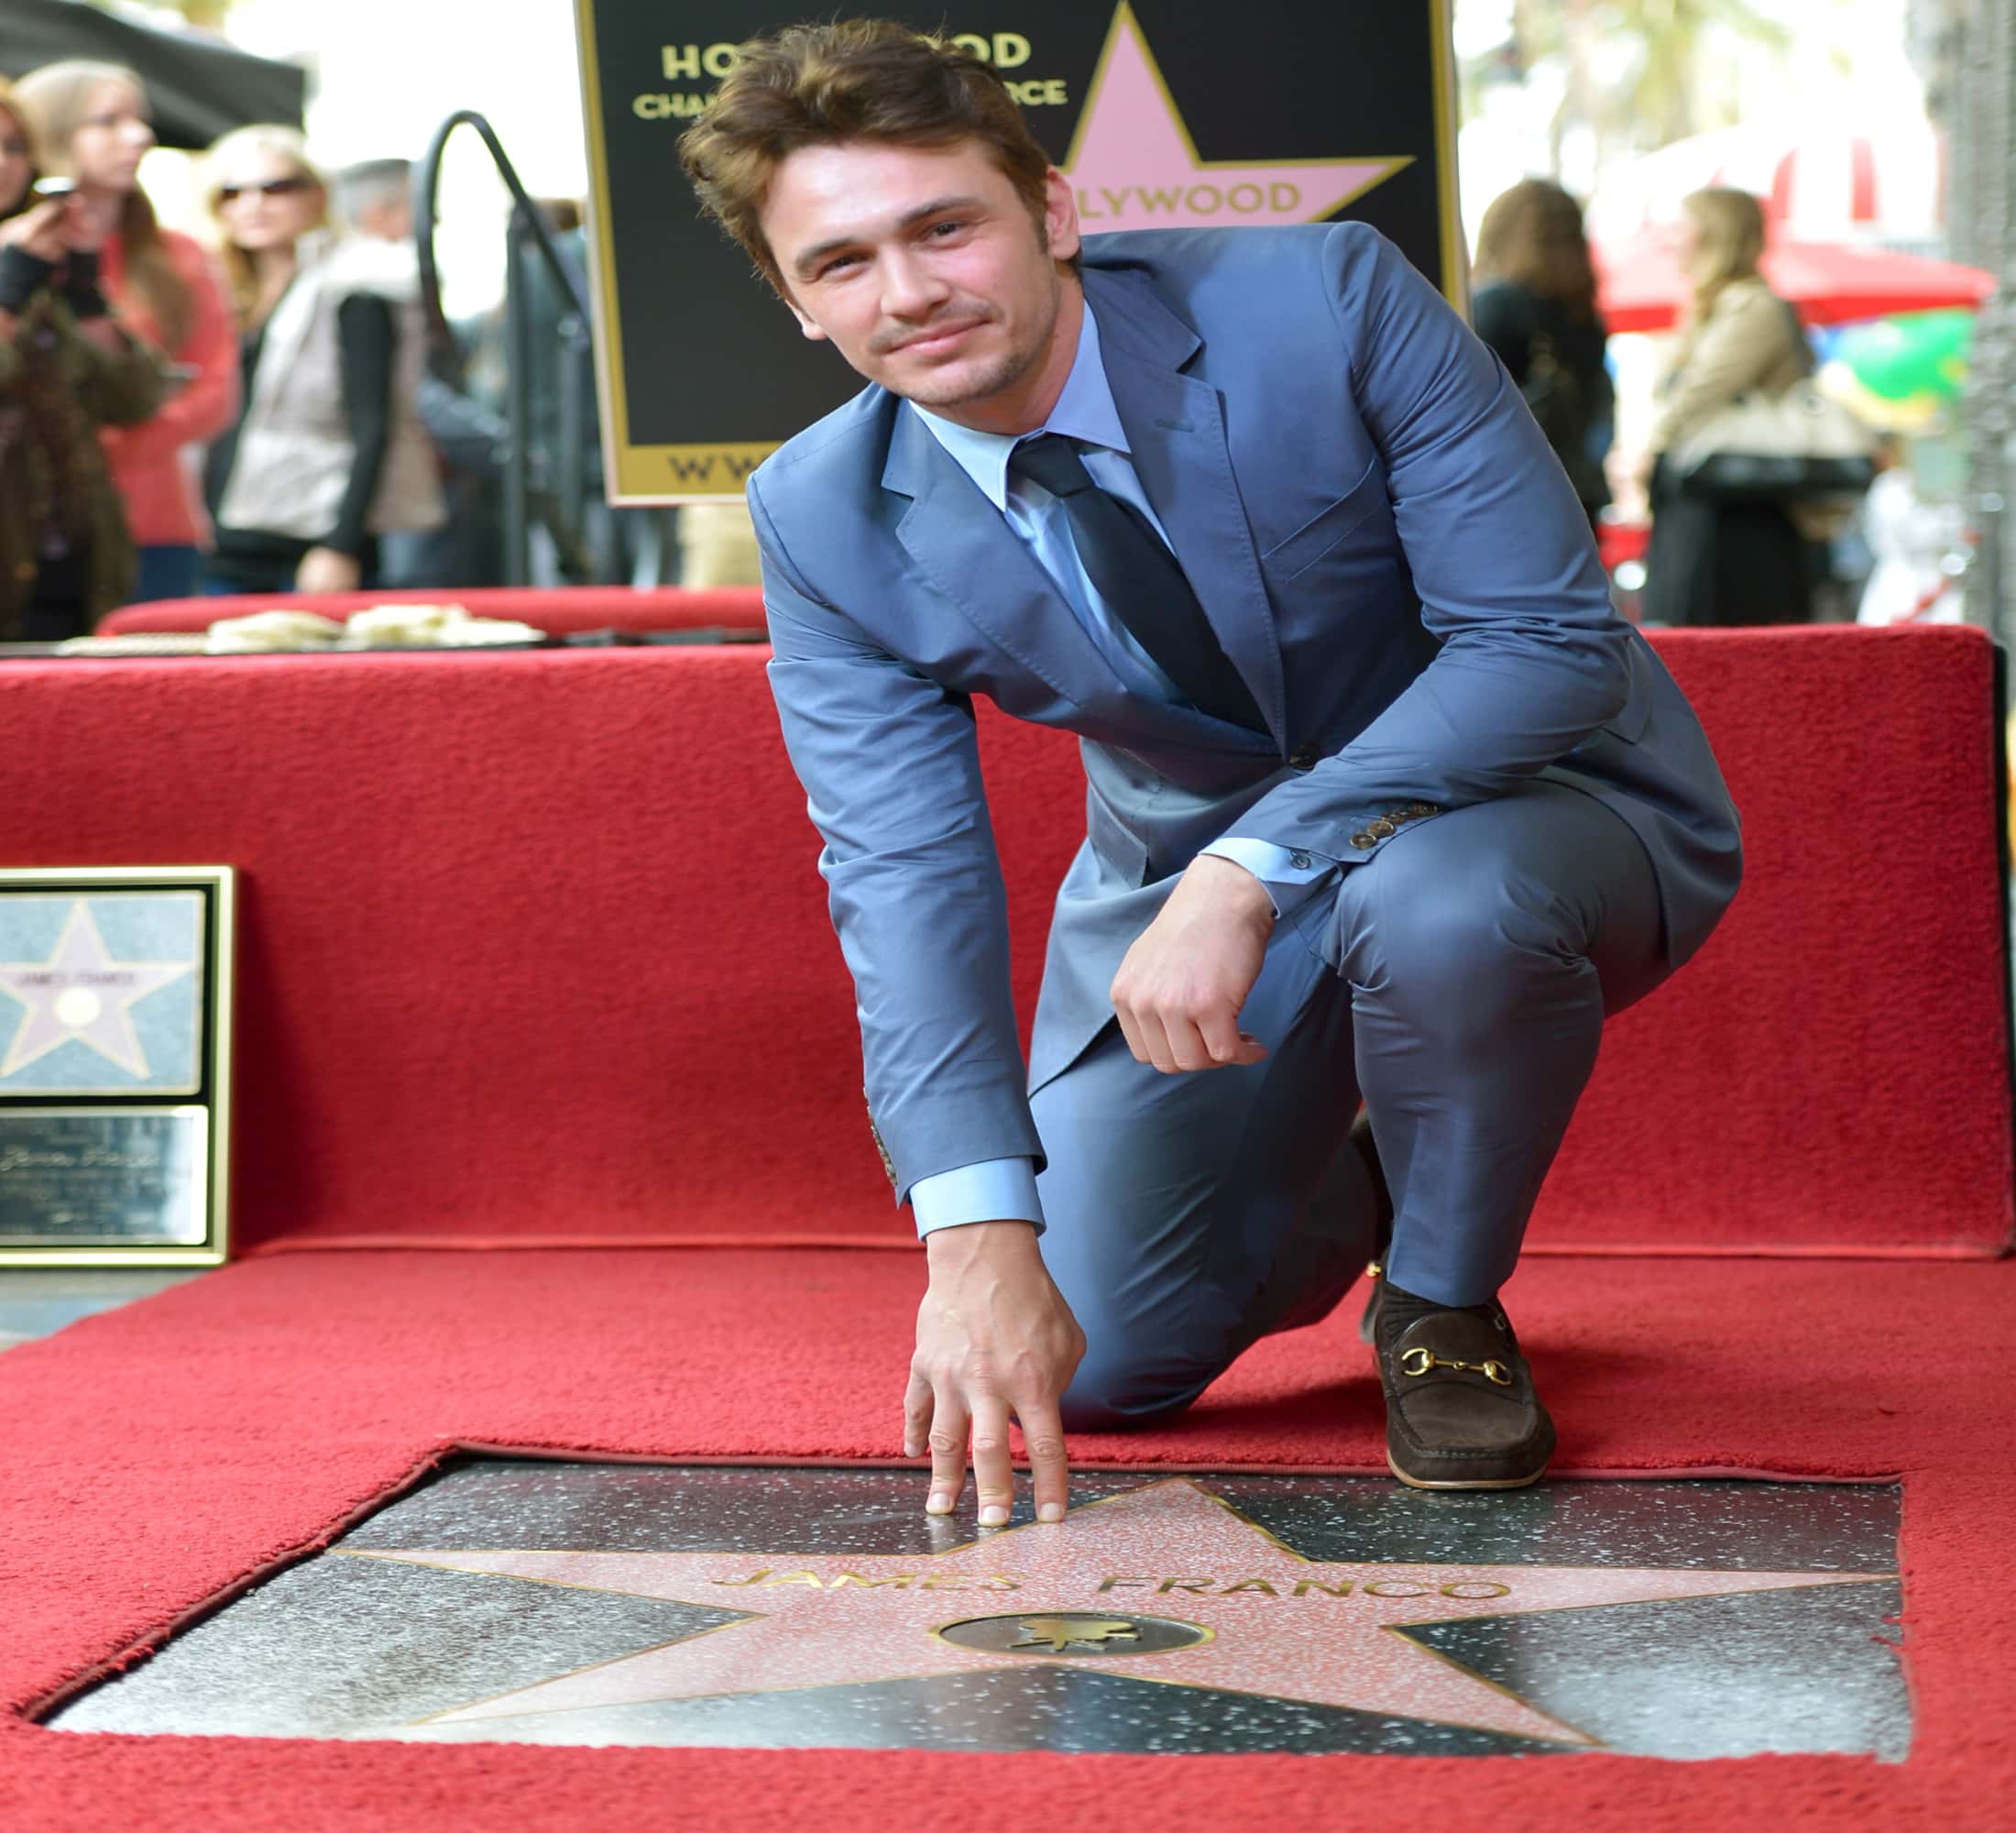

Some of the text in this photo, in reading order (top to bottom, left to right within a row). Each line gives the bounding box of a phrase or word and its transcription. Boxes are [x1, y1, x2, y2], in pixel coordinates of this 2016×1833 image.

[1078, 181, 1301, 218] LYWOOD
[711, 1568, 1511, 1598] JAMES FRANCO
